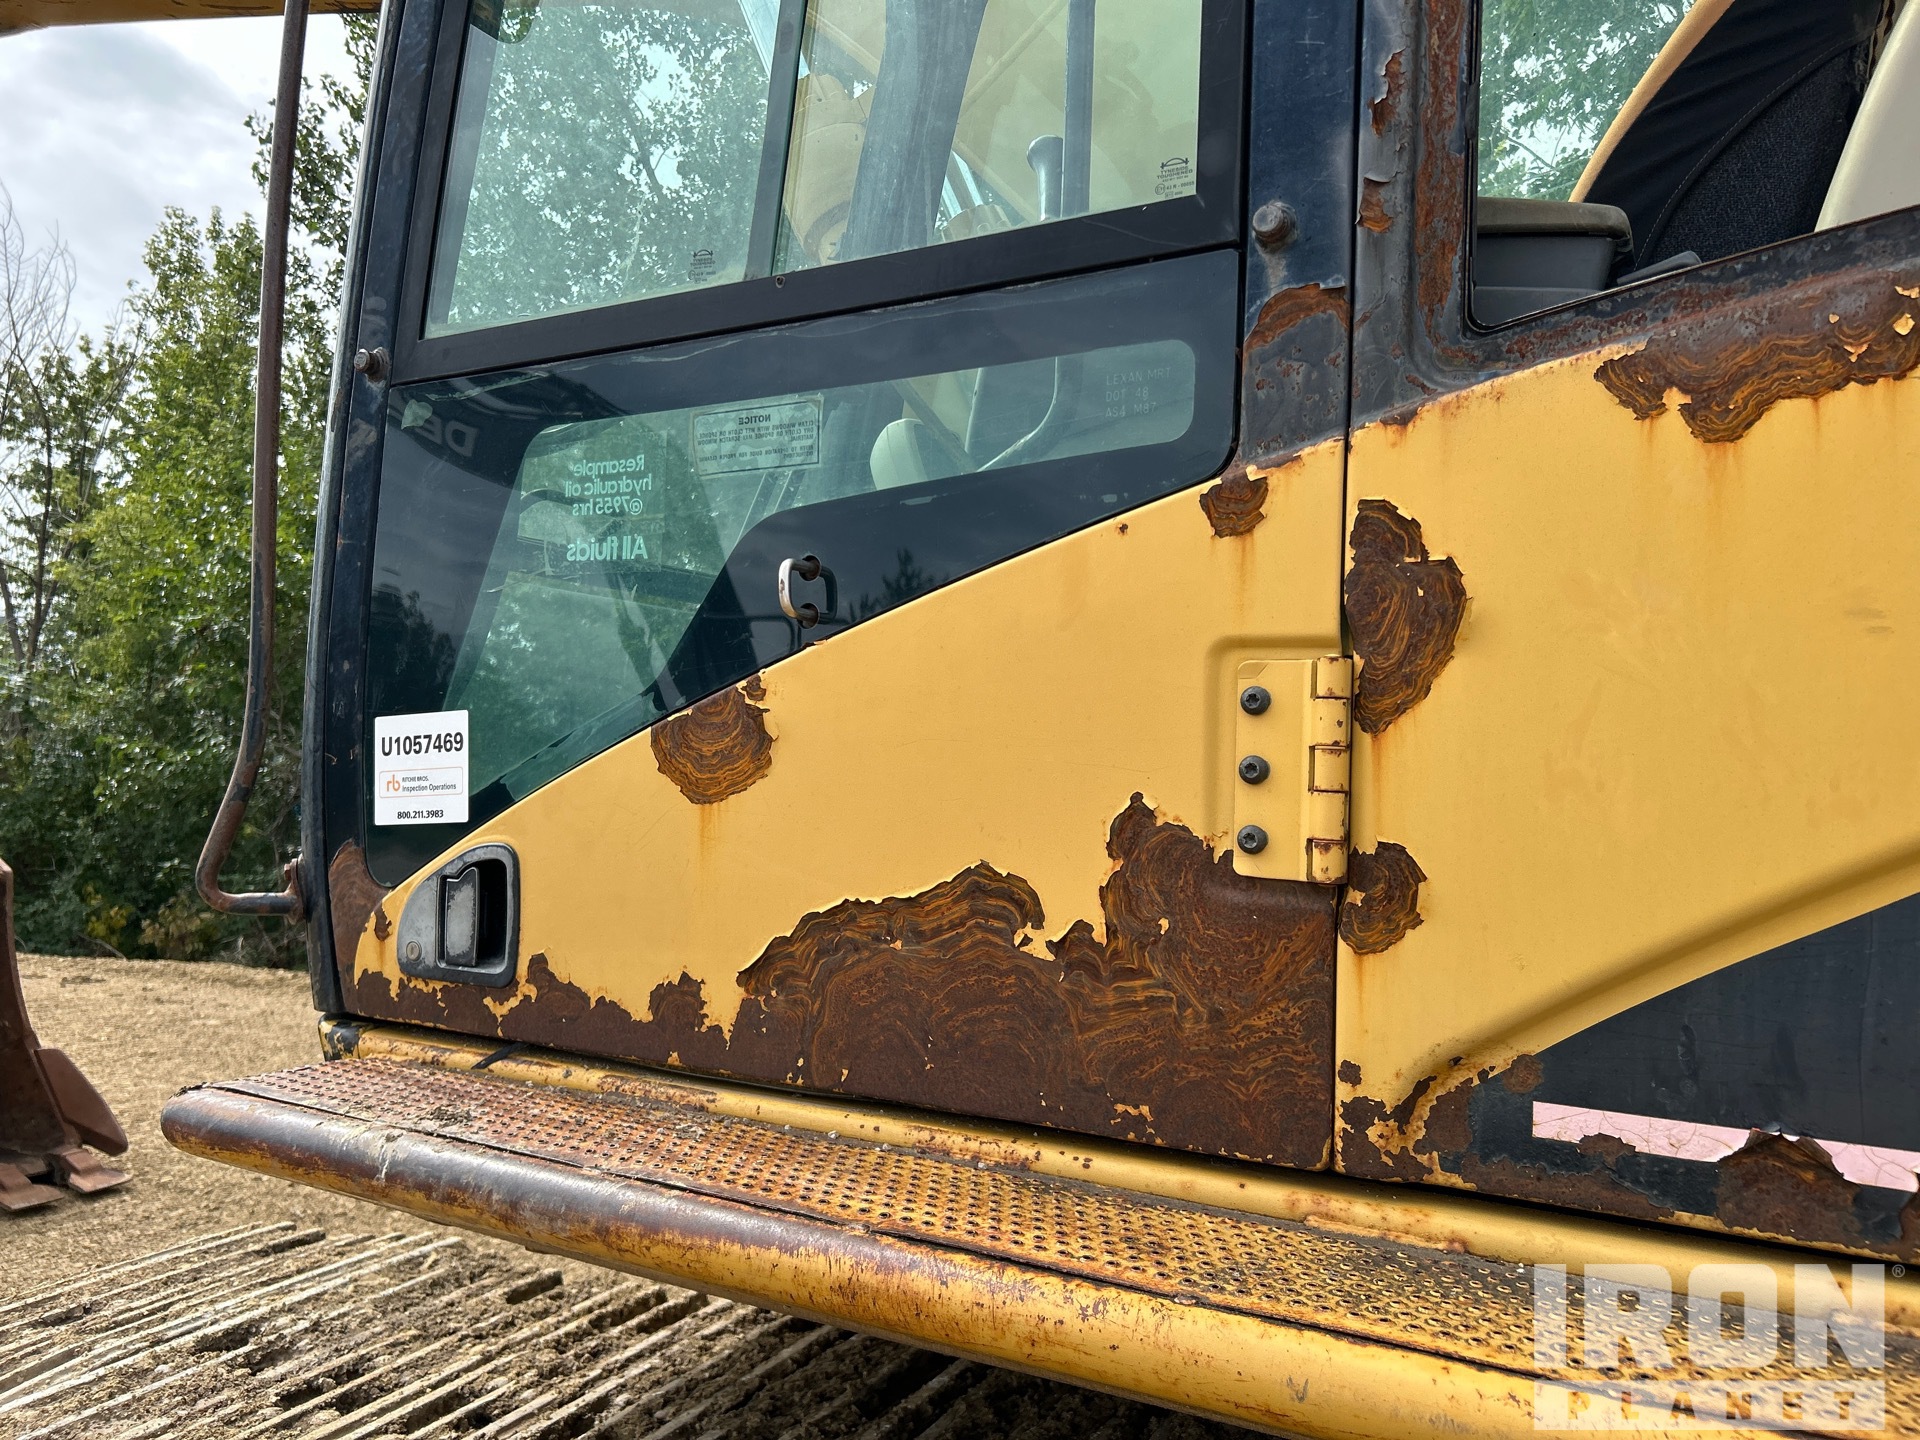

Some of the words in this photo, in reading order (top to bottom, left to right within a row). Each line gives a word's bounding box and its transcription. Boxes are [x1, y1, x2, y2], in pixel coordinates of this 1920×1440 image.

[1106, 371, 1142, 386] LEXAN
[1147, 367, 1171, 380] MRT
[1106, 389, 1127, 402] DOT
[382, 732, 464, 756] U1057469
[402, 784, 428, 794] Inspection
[428, 783, 456, 792] Operations
[397, 810, 444, 820] 800.211.3983
